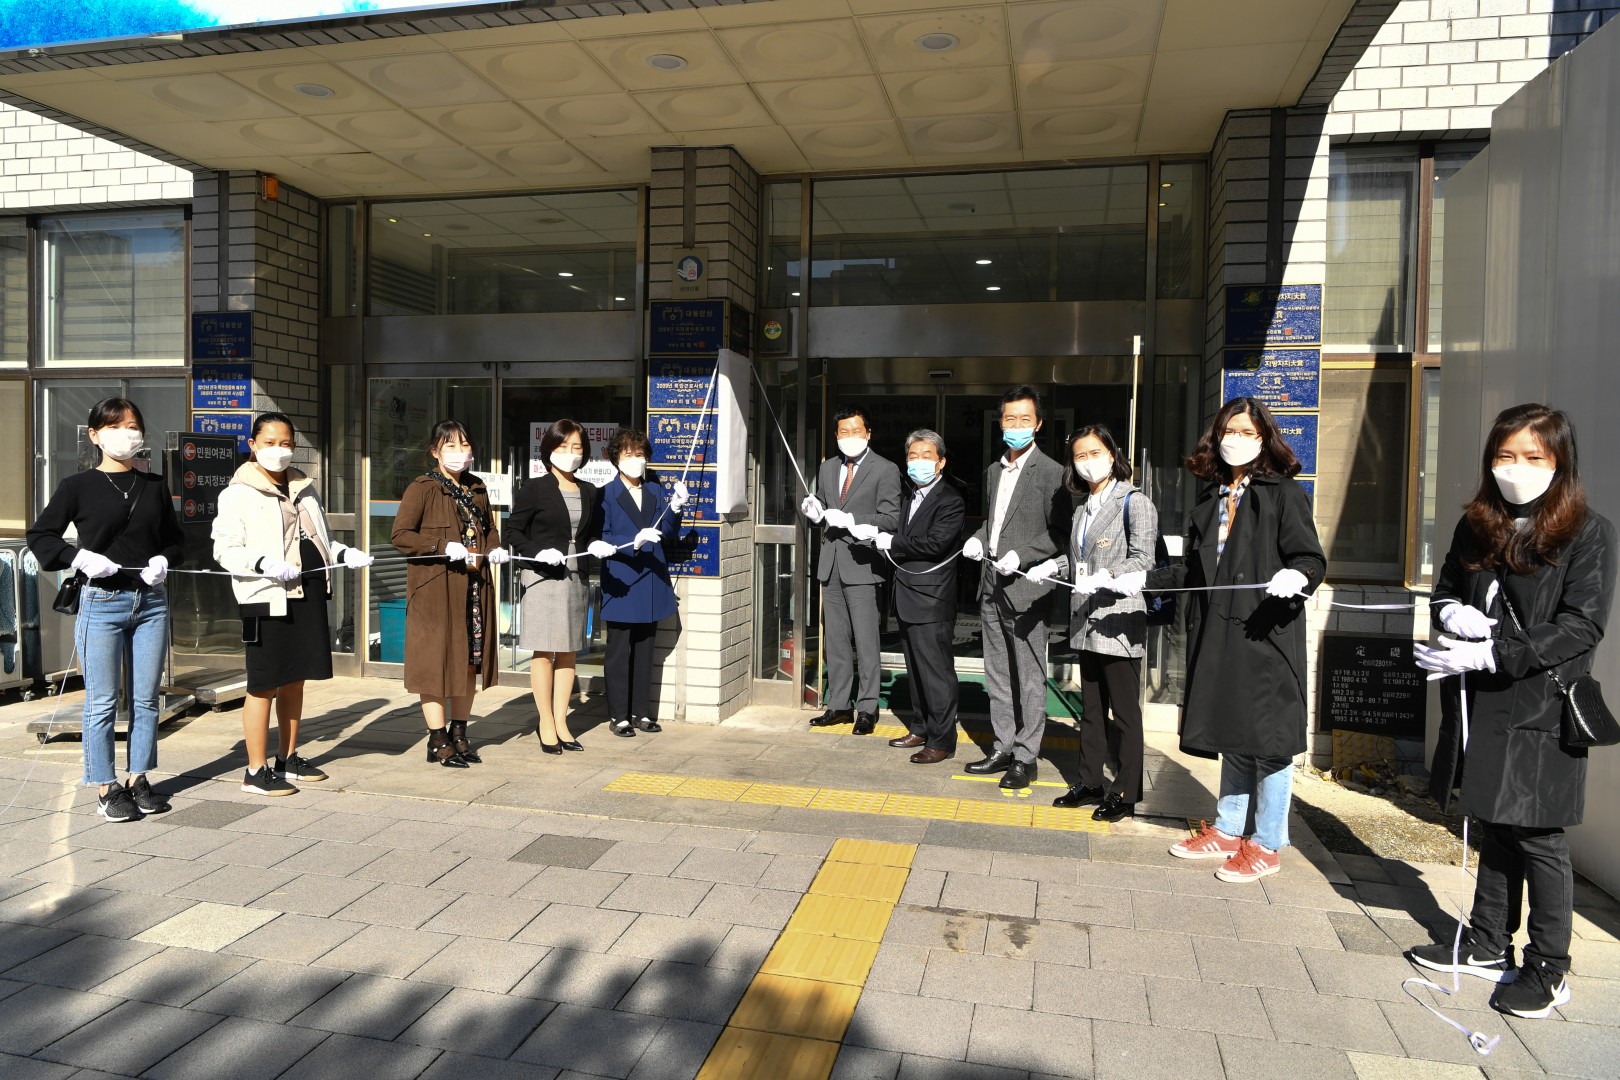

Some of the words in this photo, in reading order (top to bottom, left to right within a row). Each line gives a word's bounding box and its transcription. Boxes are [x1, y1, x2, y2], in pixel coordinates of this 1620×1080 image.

[686, 310, 713, 318] 대통령상
[197, 447, 233, 459] 민원여권과
[1356, 646, 1366, 657] 定
